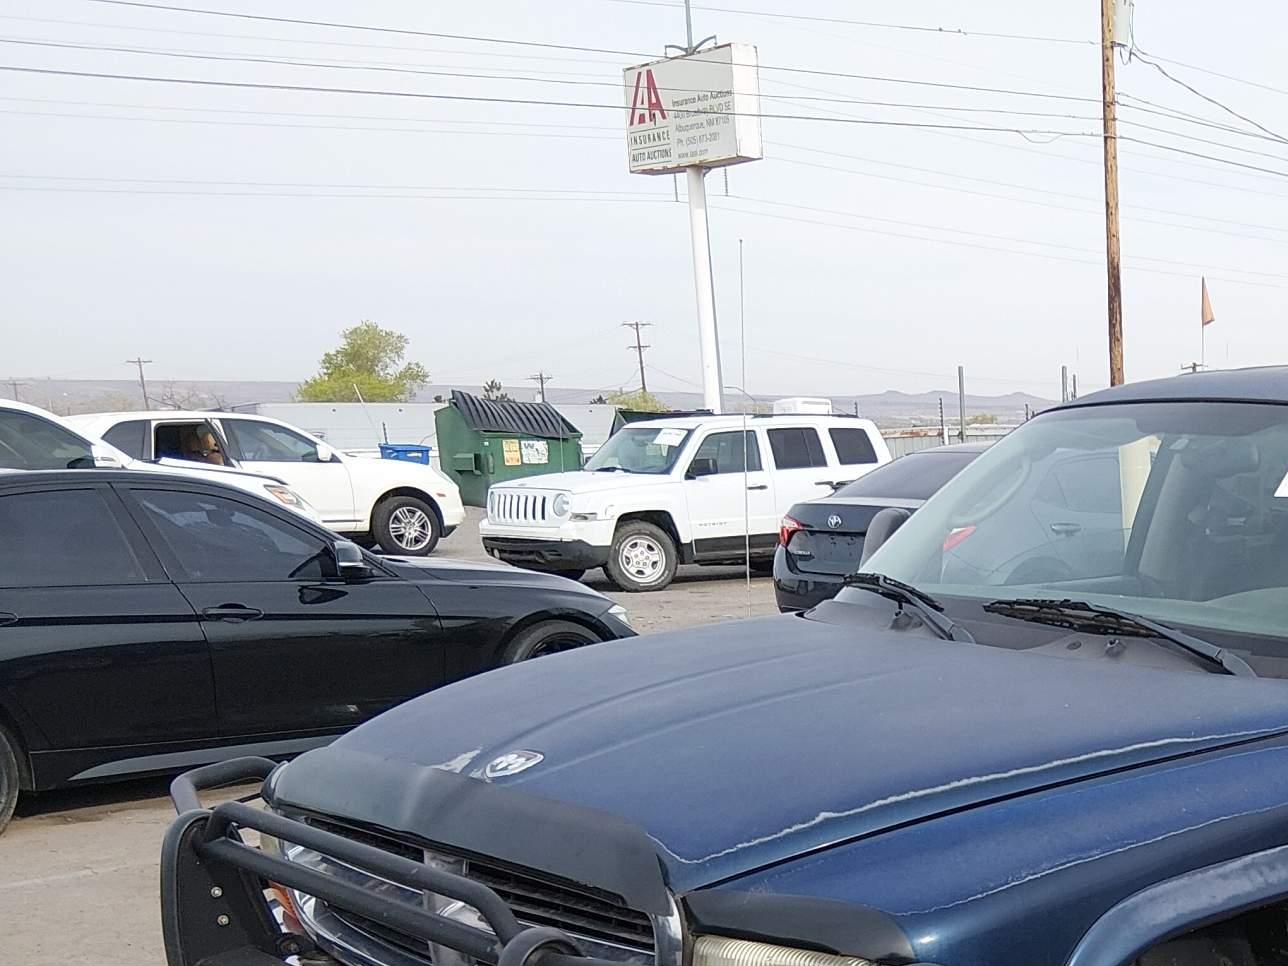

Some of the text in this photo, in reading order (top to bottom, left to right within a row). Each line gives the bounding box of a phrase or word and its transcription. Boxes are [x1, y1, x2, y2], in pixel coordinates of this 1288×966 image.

[672, 89, 733, 108] Insurance Auto Auctions
[724, 101, 732, 111] SE
[630, 130, 670, 146] INSURANCE
[632, 148, 672, 162] AUTO AUCTIONS
